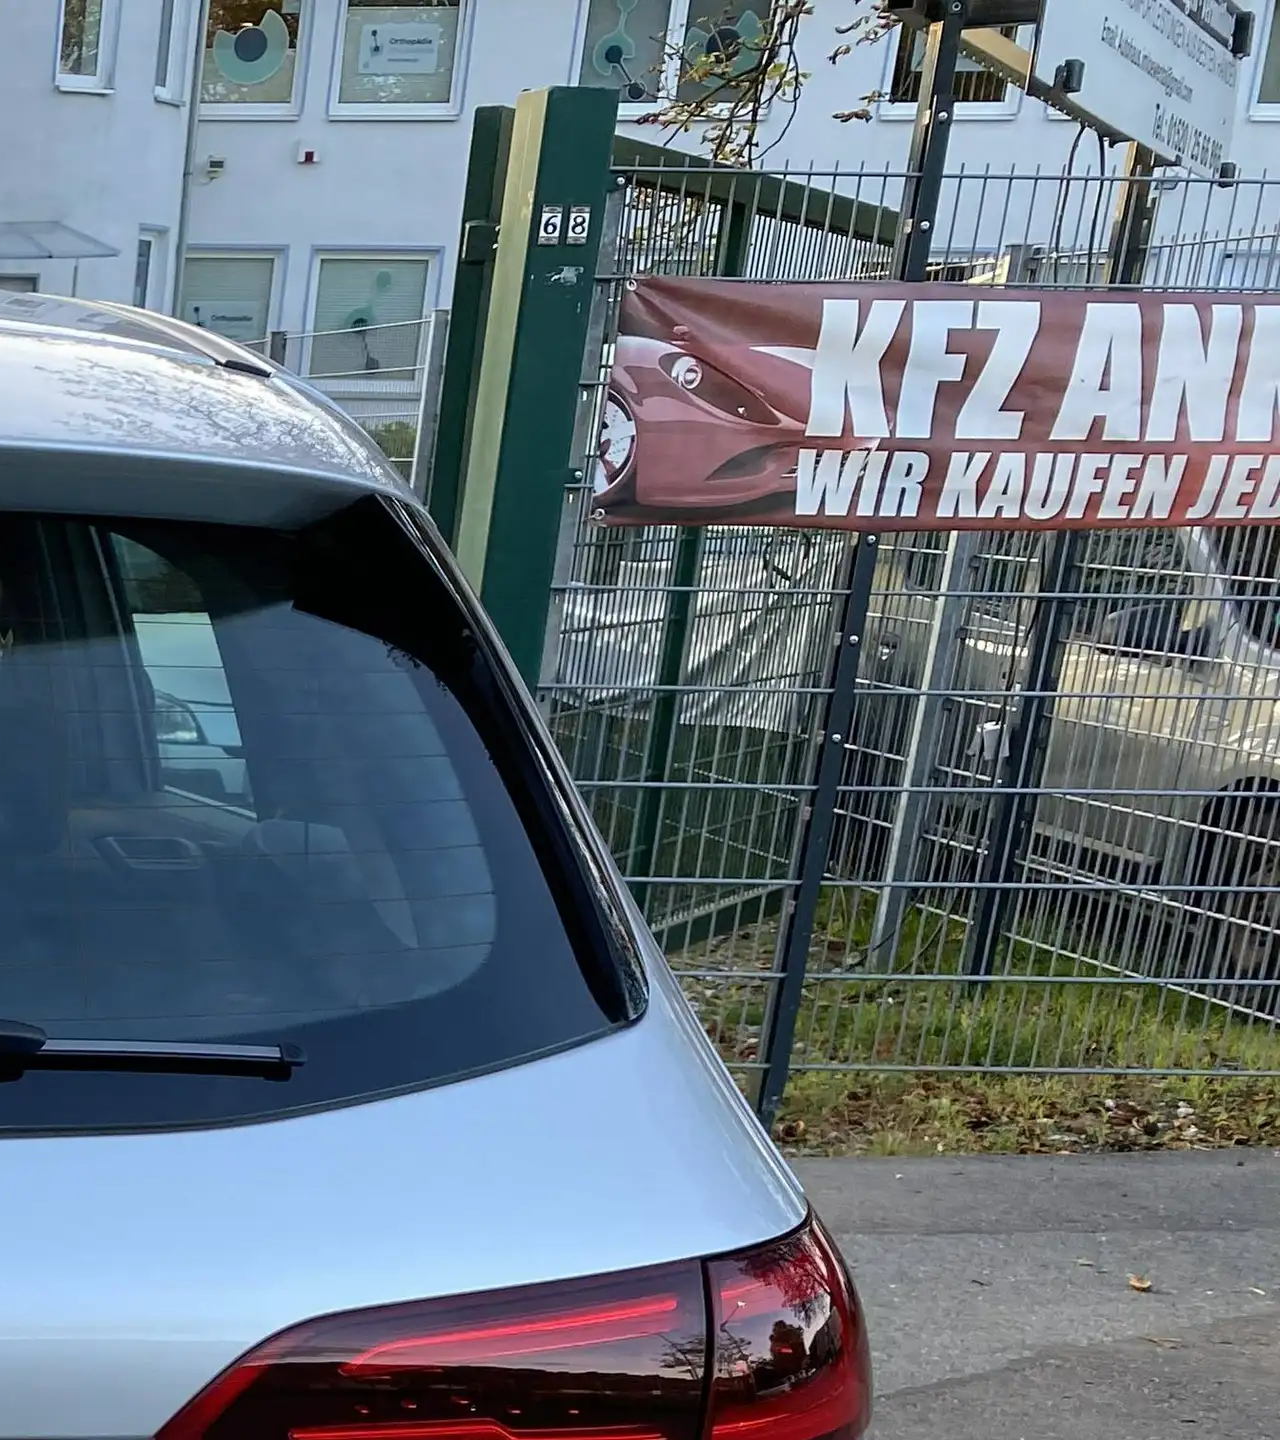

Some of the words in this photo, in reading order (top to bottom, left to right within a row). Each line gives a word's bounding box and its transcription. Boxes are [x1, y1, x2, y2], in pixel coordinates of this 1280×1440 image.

[804, 299, 1041, 441] KFZ
[794, 448, 929, 518] WIR
[936, 451, 1187, 520] KAUFEN
